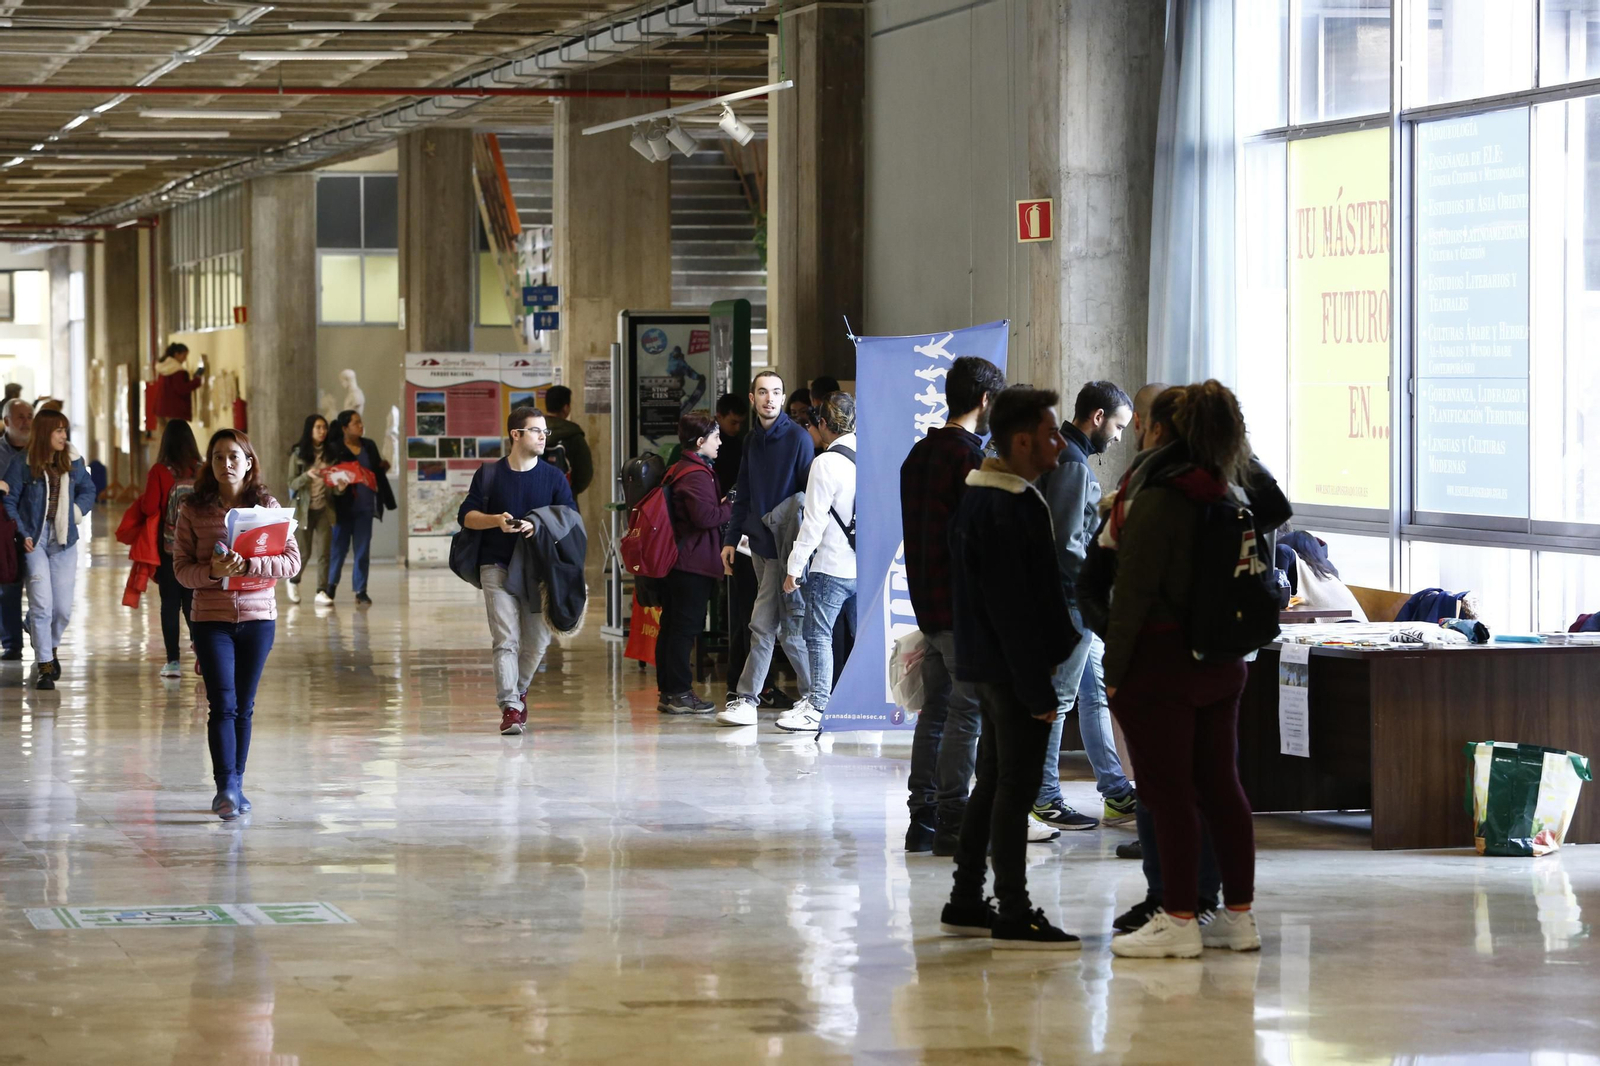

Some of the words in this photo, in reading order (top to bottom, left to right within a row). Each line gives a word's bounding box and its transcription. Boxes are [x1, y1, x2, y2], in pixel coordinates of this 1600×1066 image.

[1429, 118, 1478, 141] ARQUEOLOGÍA
[1429, 152, 1470, 171] ENSEÑANZA
[1471, 151, 1482, 166] DE
[1483, 144, 1503, 164] ELE:
[1429, 198, 1464, 216] ESTUDIOS
[1466, 198, 1476, 213] DE
[1478, 193, 1496, 212] ASIA
[1295, 207, 1316, 259] TU
[1322, 185, 1390, 257] MÁSTER
[1428, 273, 1464, 291] ESTUDIOS
[1465, 270, 1510, 289] LITERARIOS
[1511, 271, 1517, 288] Y
[1428, 294, 1469, 312] TEATRALES
[1321, 289, 1390, 344] FUTURO
[1428, 323, 1464, 341] CULTURAS
[1465, 317, 1491, 341] ÁRABE
[1492, 325, 1497, 341] Y
[1428, 384, 1476, 404] GOBERNANZA,
[1478, 384, 1520, 403] LIDERAZGO
[1521, 387, 1528, 403] Y
[1348, 385, 1390, 439] EN...
[1428, 405, 1483, 424] PLANIFICACIÓN
[1428, 434, 1460, 452] LENGUAS
[1461, 438, 1467, 452] Y
[1468, 435, 1506, 455] CULTURAS
[1428, 455, 1466, 474] MODERNAS
